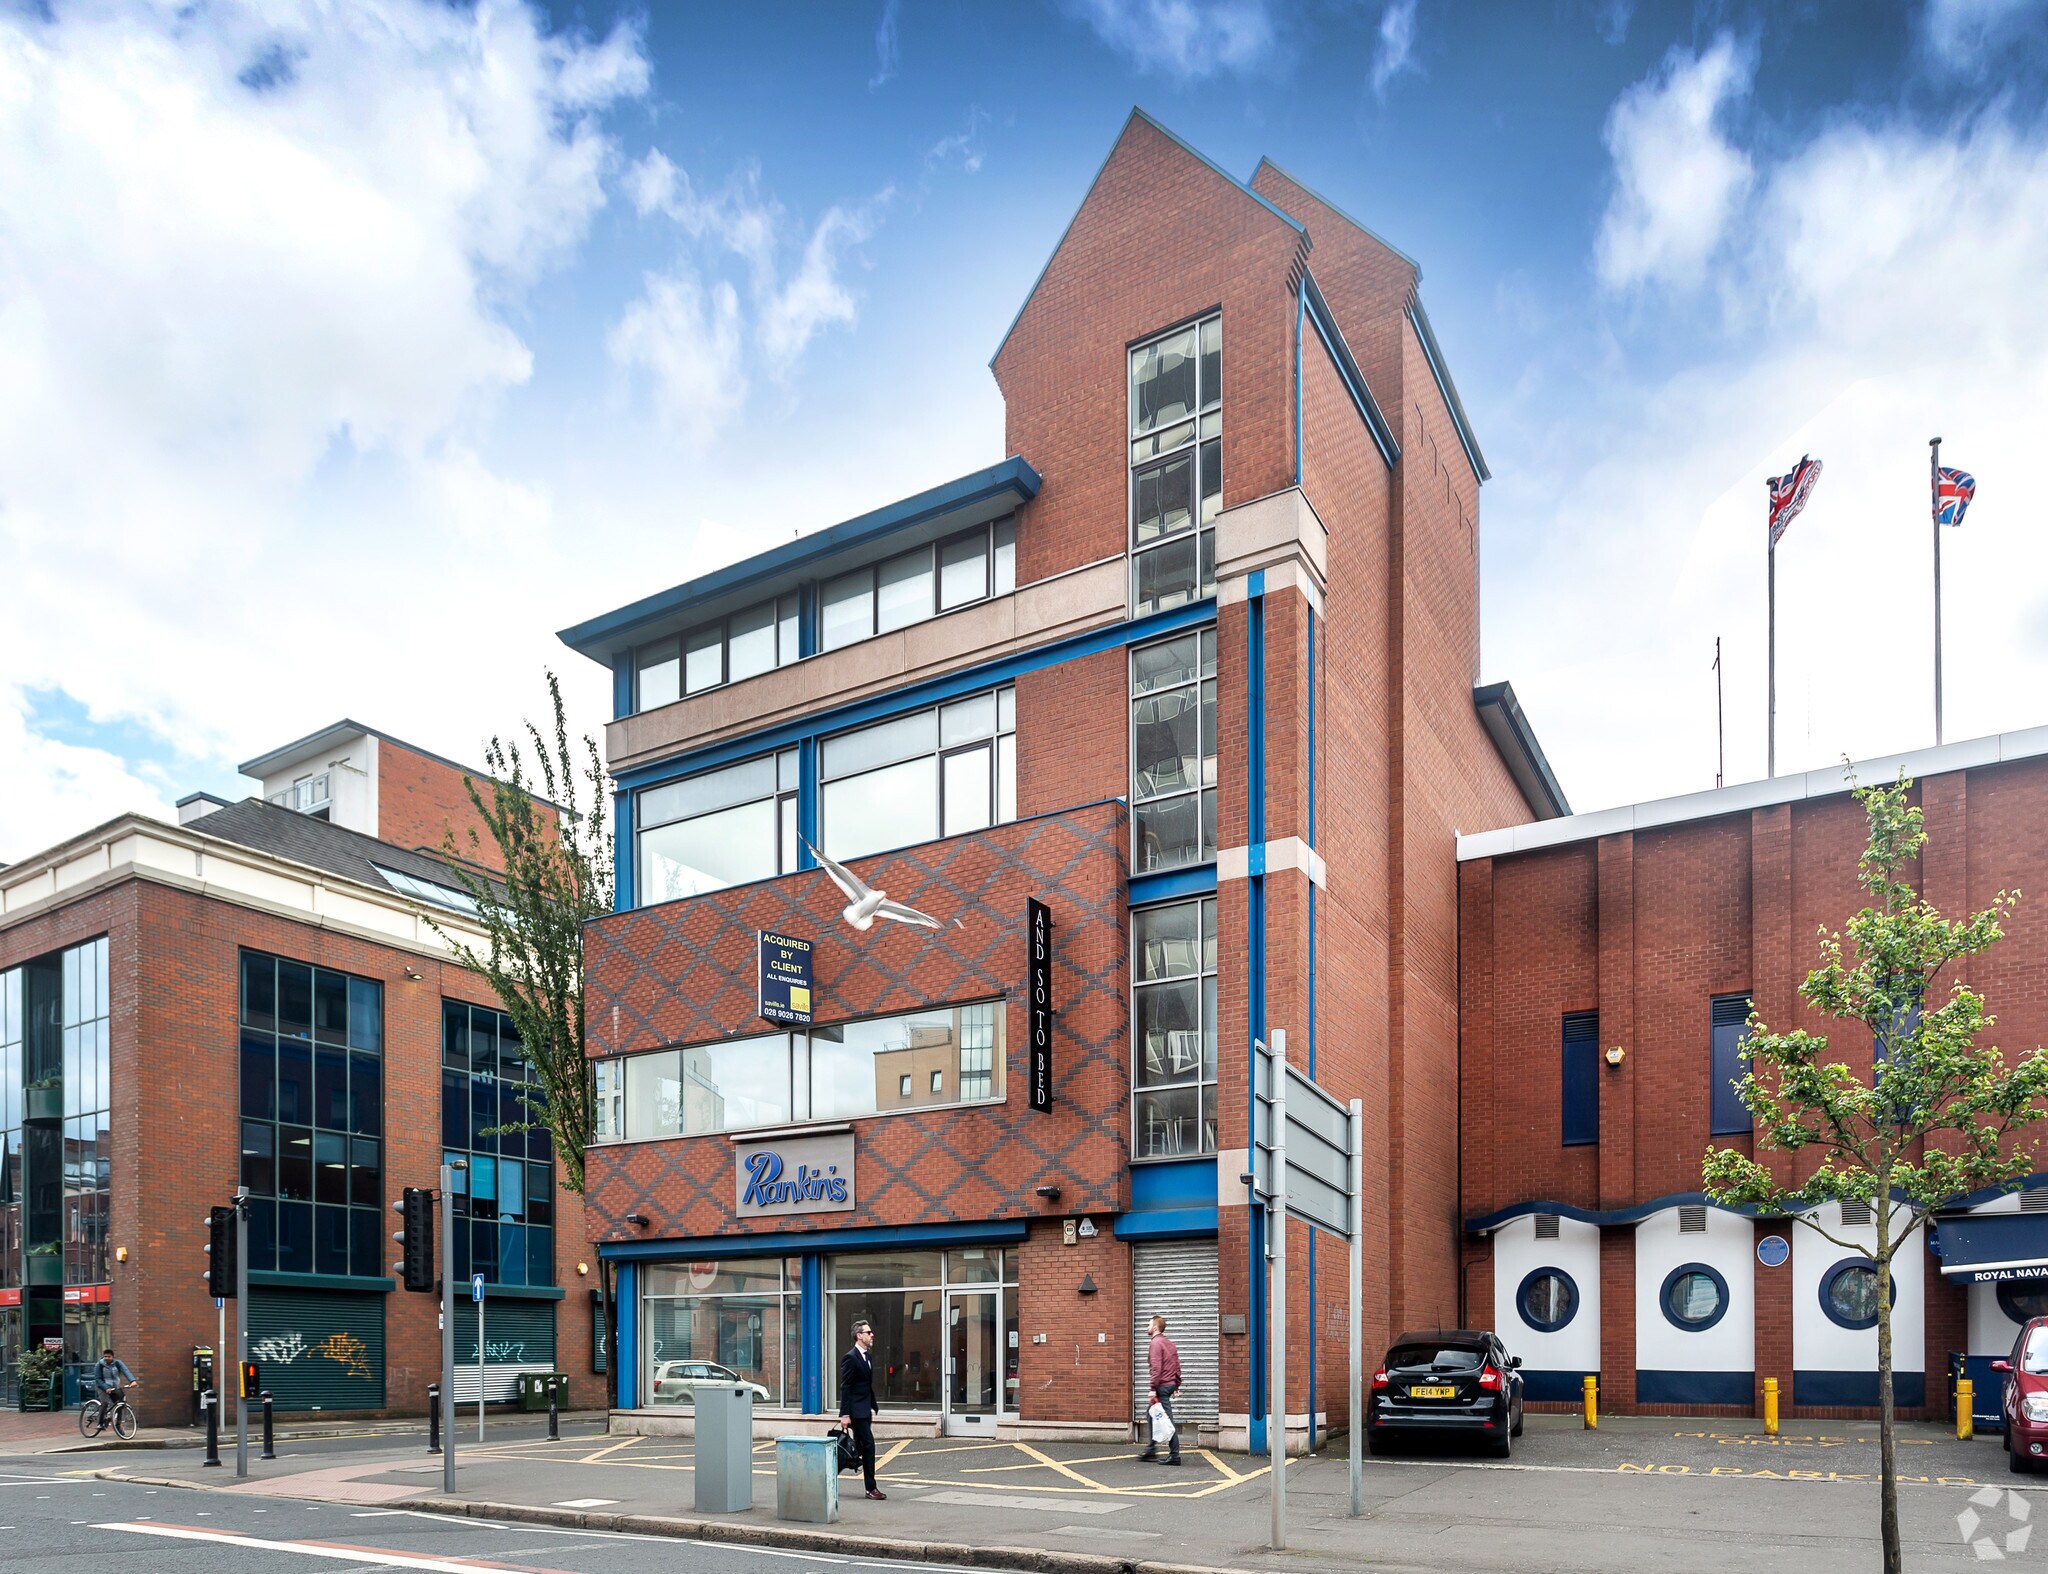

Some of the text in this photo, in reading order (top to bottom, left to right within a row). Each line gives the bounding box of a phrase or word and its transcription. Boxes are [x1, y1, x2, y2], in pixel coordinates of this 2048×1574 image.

[763, 934, 810, 951] ACQUIRED
[780, 949, 793, 960] BY
[771, 960, 802, 974] CLIENT
[778, 975, 807, 986] ENQUIRIES
[791, 1002, 809, 1012] savills
[1035, 909, 1046, 1105] AND SO TO BED
[764, 1007, 811, 1023] 028 9026 7820
[742, 1151, 847, 1206] Rankin's
[1974, 1270, 2015, 1281] ROYAL
[1718, 1439, 1844, 1447] ONLY
[1616, 1462, 1690, 1474] NO
